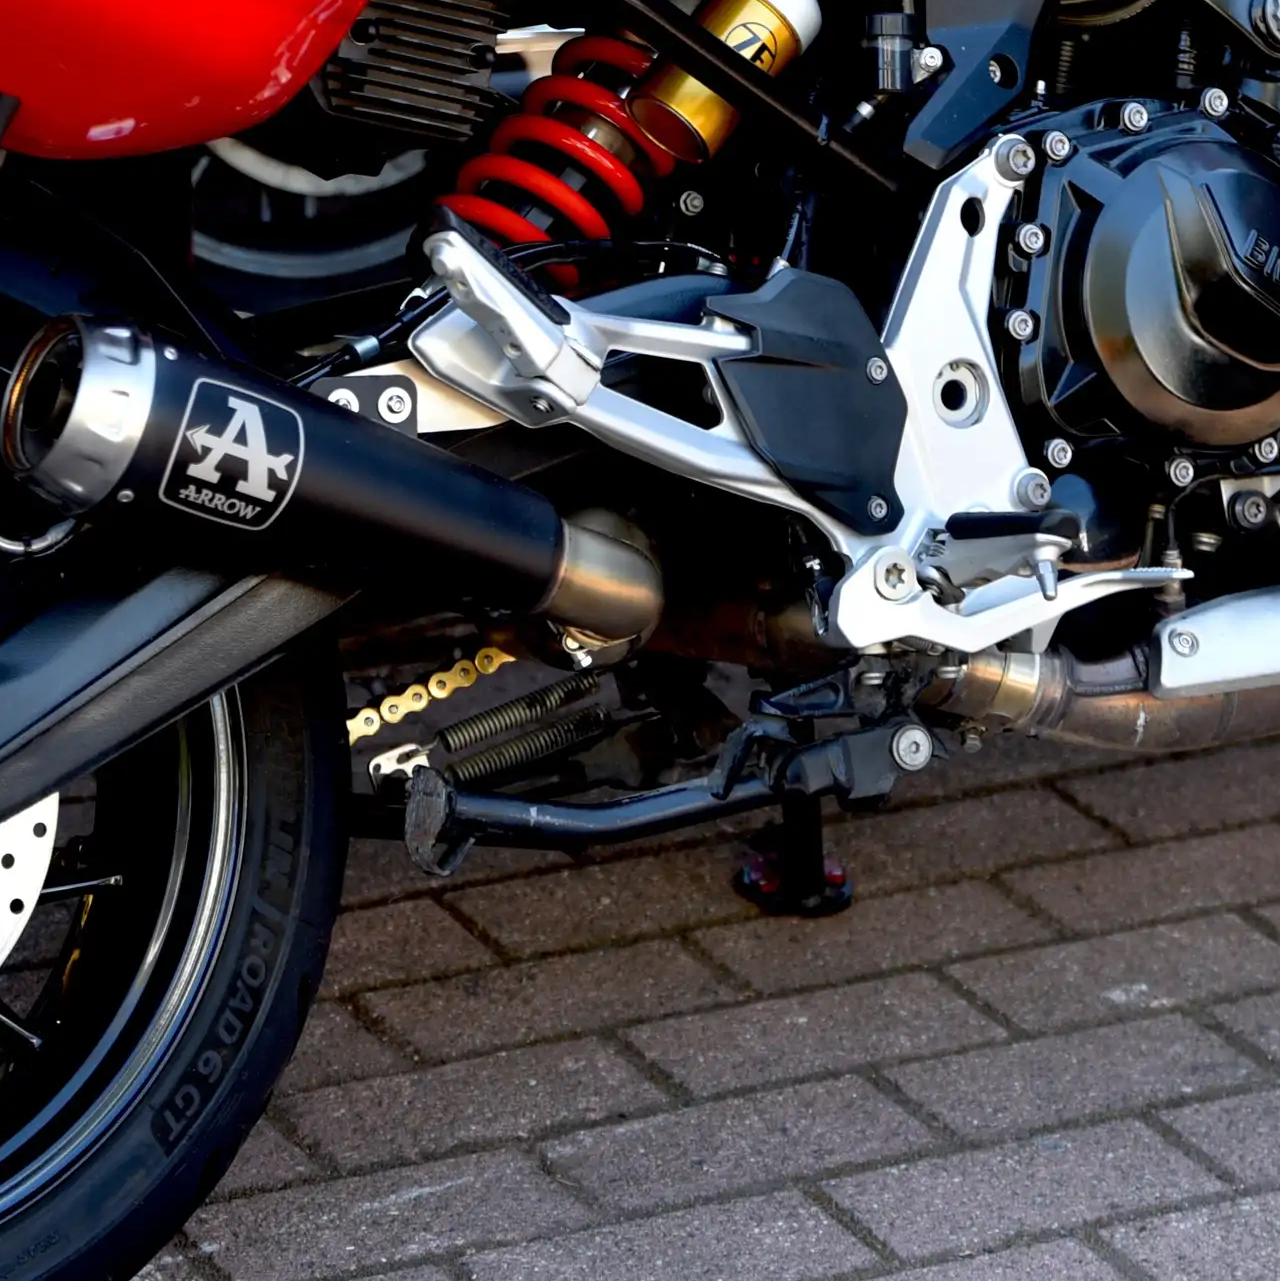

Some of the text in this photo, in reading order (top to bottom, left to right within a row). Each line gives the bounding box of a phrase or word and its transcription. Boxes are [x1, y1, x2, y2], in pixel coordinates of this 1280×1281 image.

[179, 484, 261, 519] ARROW
[218, 921, 276, 1046] ROAD
[163, 1083, 202, 1142] GT
